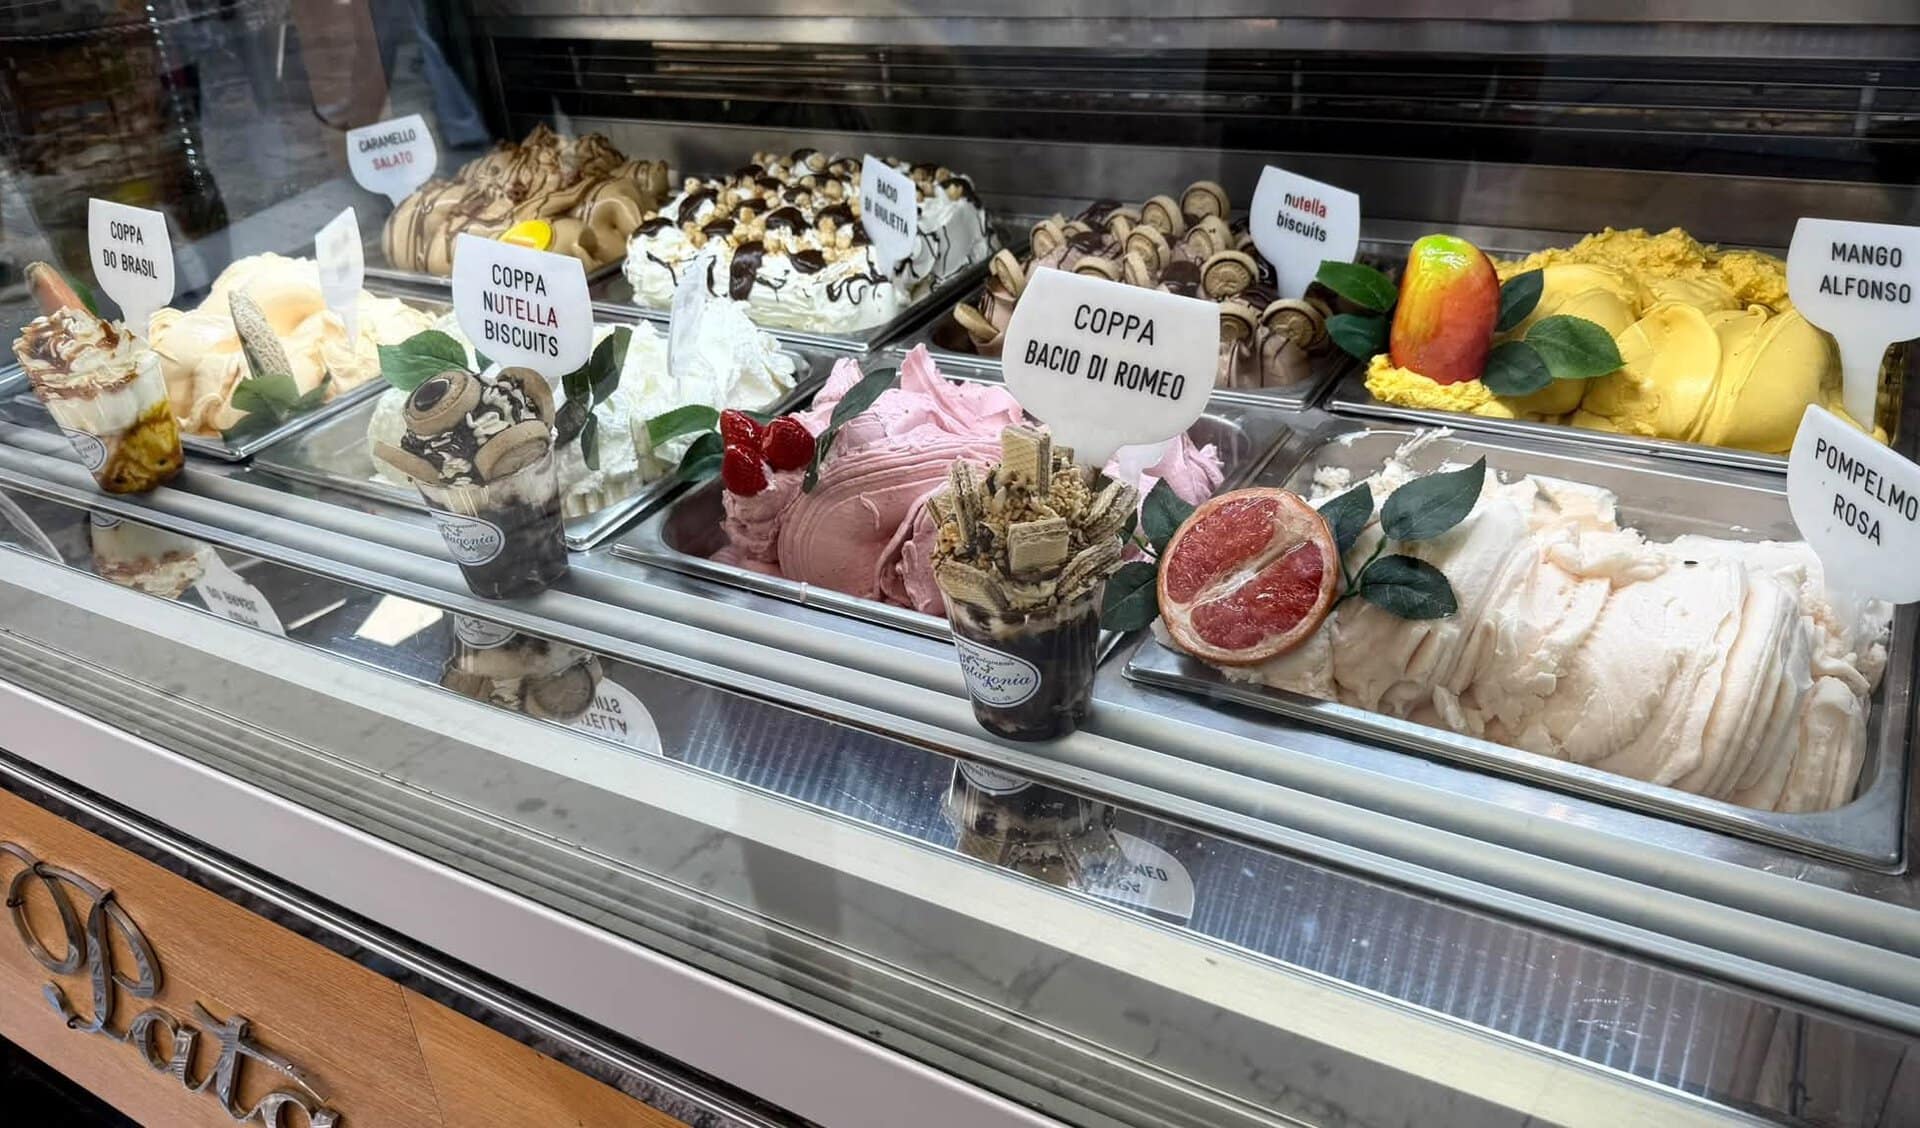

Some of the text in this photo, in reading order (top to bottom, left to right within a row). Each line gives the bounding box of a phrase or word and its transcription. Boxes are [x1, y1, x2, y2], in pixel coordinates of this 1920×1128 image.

[359, 128, 416, 153] CARAMELLO
[372, 150, 414, 171] SALATO
[877, 178, 898, 203] BACIO
[1284, 192, 1327, 218] nutella
[110, 220, 144, 245] COPPA
[1276, 209, 1327, 242] biscuits
[103, 248, 158, 280] DO BRASIL
[1831, 241, 1902, 268] MANGO
[492, 263, 547, 297] COPPA
[1819, 274, 1911, 304] ALFONSO
[483, 290, 558, 328] NUTELLA
[1074, 304, 1154, 346] COPPA
[484, 319, 559, 357] BISCUITS
[1024, 339, 1185, 401] BACIO DI ROMEO
[1815, 437, 1919, 521] POMPELMO
[1832, 493, 1881, 547] ROSA
